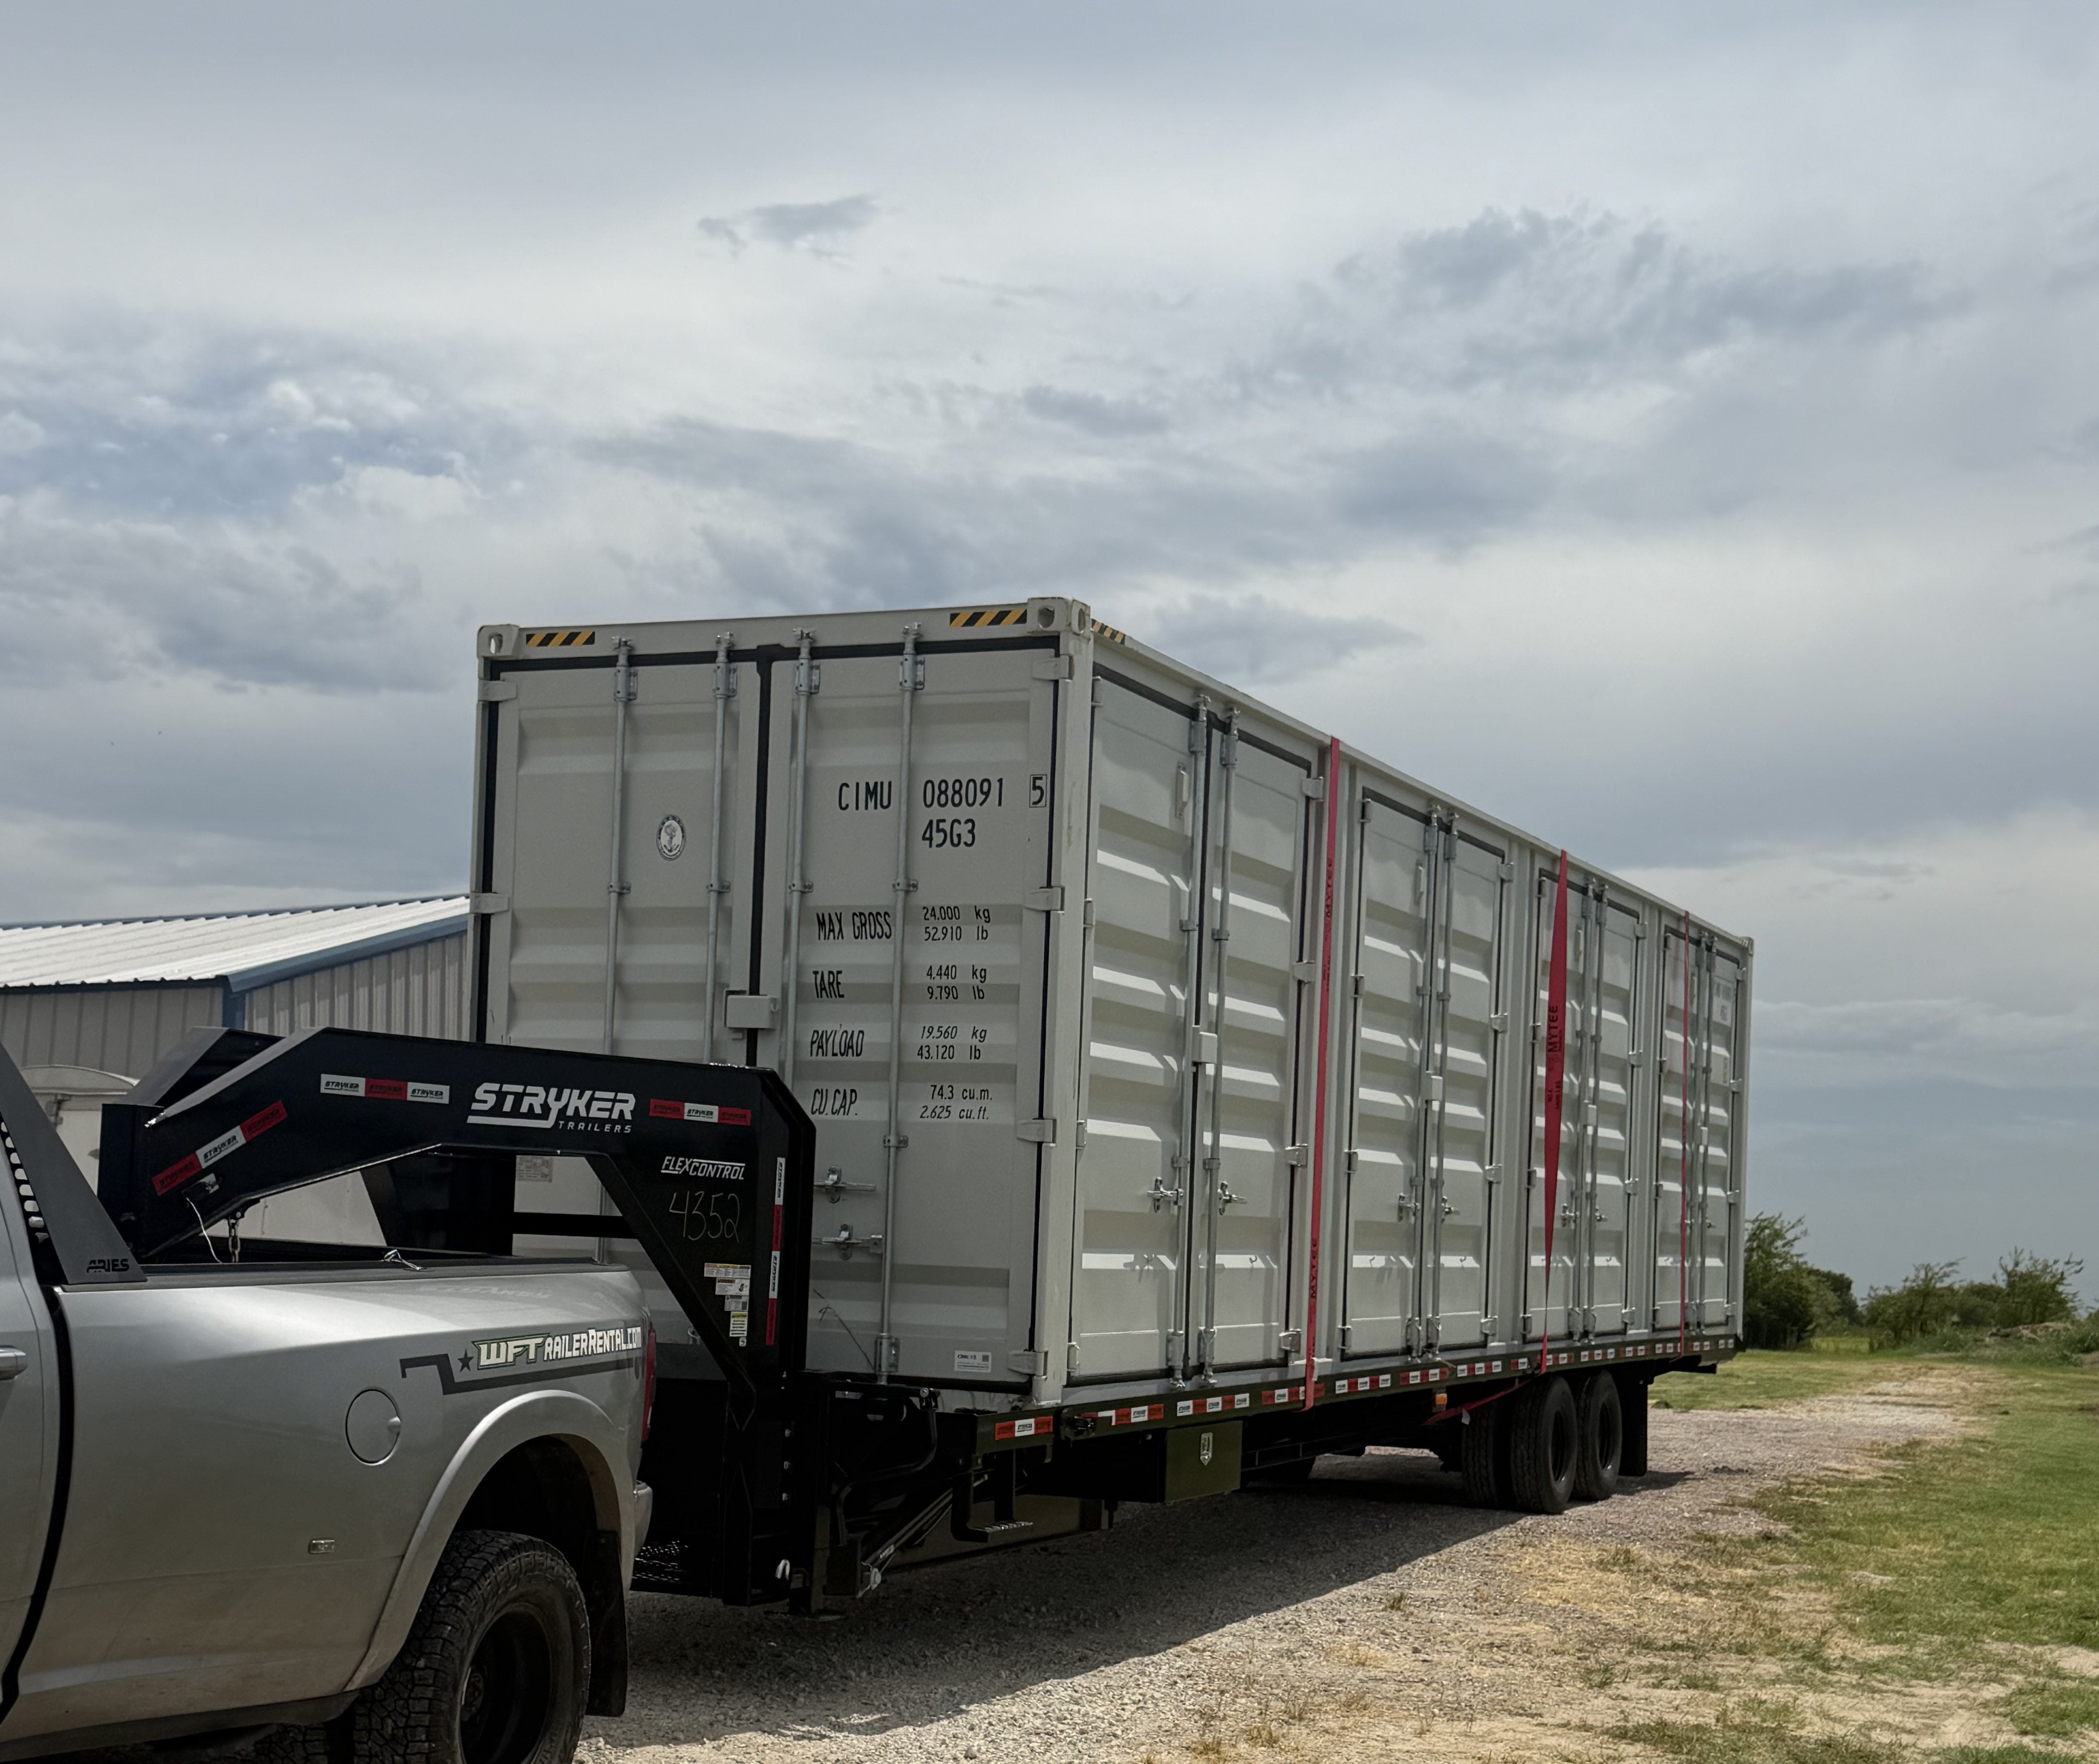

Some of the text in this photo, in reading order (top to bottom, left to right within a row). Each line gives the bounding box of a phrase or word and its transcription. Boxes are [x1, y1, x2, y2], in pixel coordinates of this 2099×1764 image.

[838, 776, 1045, 811] CIMU 088091 5
[921, 818, 976, 849] 45G3
[922, 906, 991, 924] 24.000 kg
[817, 912, 893, 941] MAX GROSS
[924, 925, 989, 942] 52.910 lb
[926, 964, 987, 983] 4.440 kg
[812, 970, 845, 1000] TARE
[927, 985, 985, 1001] 9.790 lb
[921, 1025, 988, 1043] 19.560 kg
[1548, 1005, 1559, 1053] MYTEE
[810, 1029, 864, 1057] PAYLOAD
[917, 1044, 981, 1060] 43.120 lb
[324, 1081, 359, 1091] STRYKER
[410, 1088, 443, 1099] STRYKER
[930, 1085, 993, 1101] 74.3 cu.m.
[468, 1082, 636, 1128] STRYKER
[811, 1088, 858, 1116] CU.CAP.
[920, 1105, 989, 1121] 2.625 cu.ft.
[558, 1121, 632, 1133] TRAILERS
[203, 1135, 237, 1162] STRYKER
[669, 1191, 741, 1243] 4352
[87, 1258, 129, 1273] ARIES
